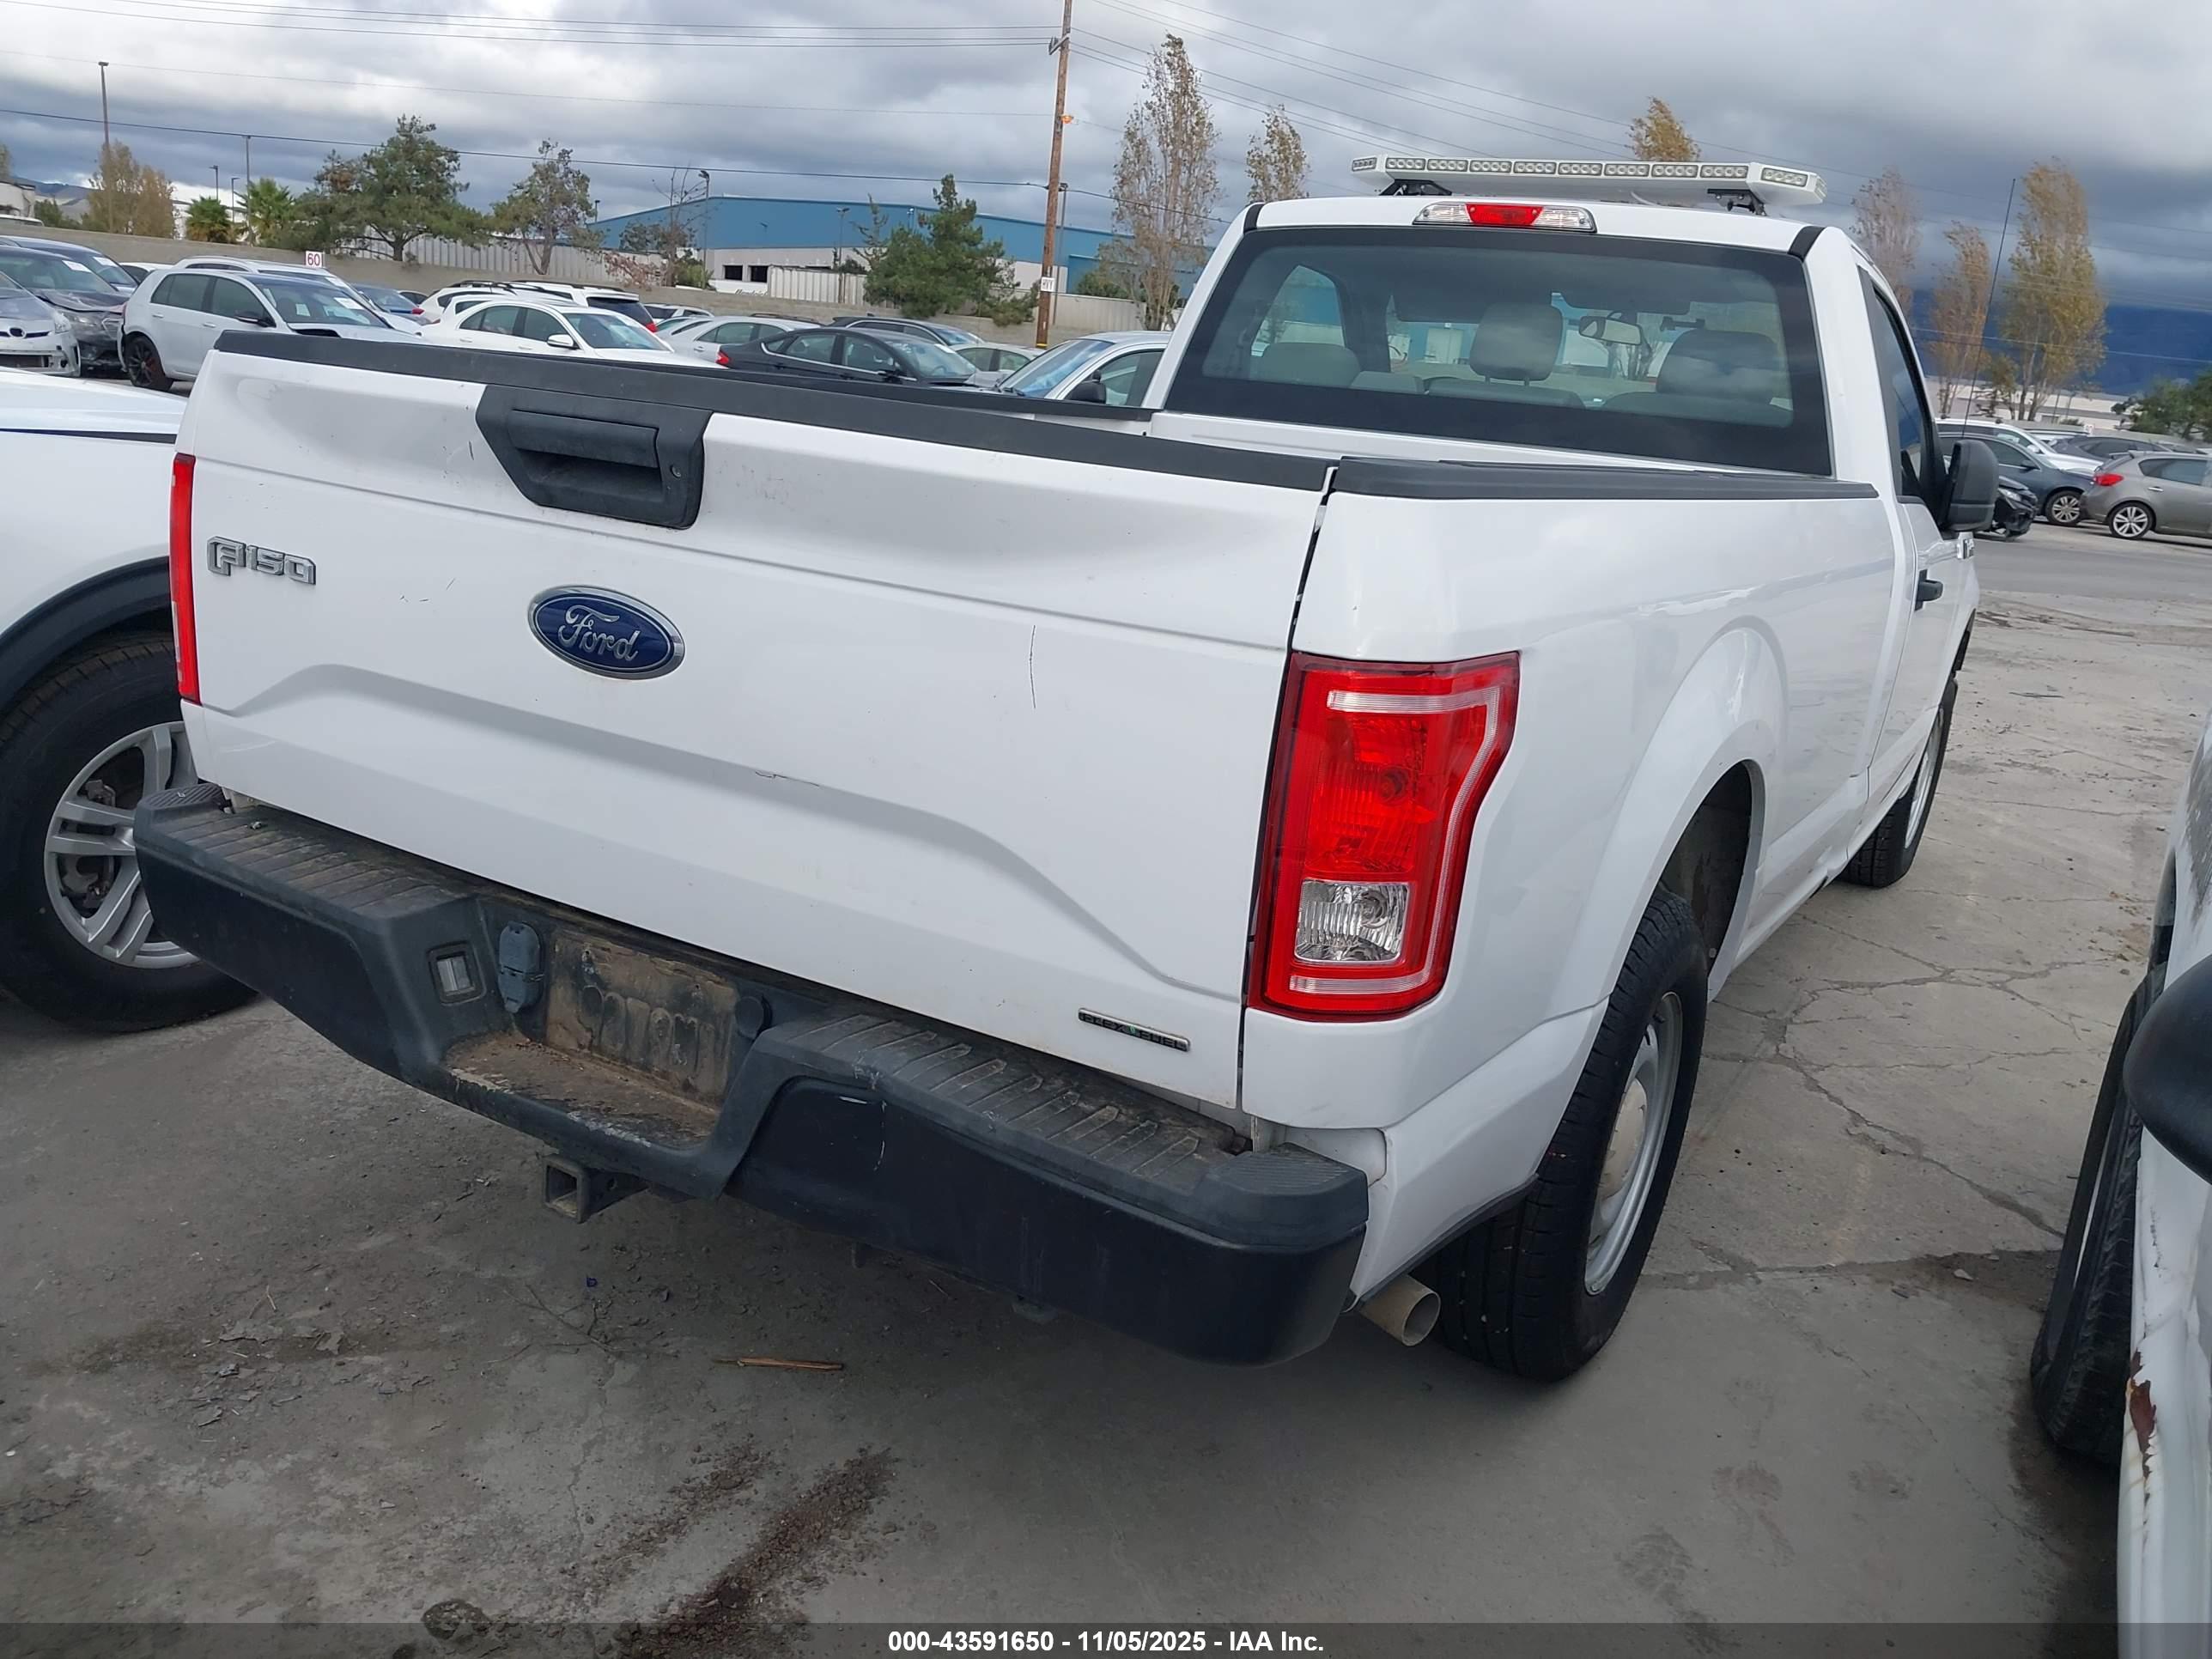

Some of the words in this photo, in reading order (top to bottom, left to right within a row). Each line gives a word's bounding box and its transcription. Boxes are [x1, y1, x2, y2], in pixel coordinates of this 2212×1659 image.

[307, 252, 320, 266] 60
[207, 536, 316, 585] F150
[558, 605, 641, 661] Ford
